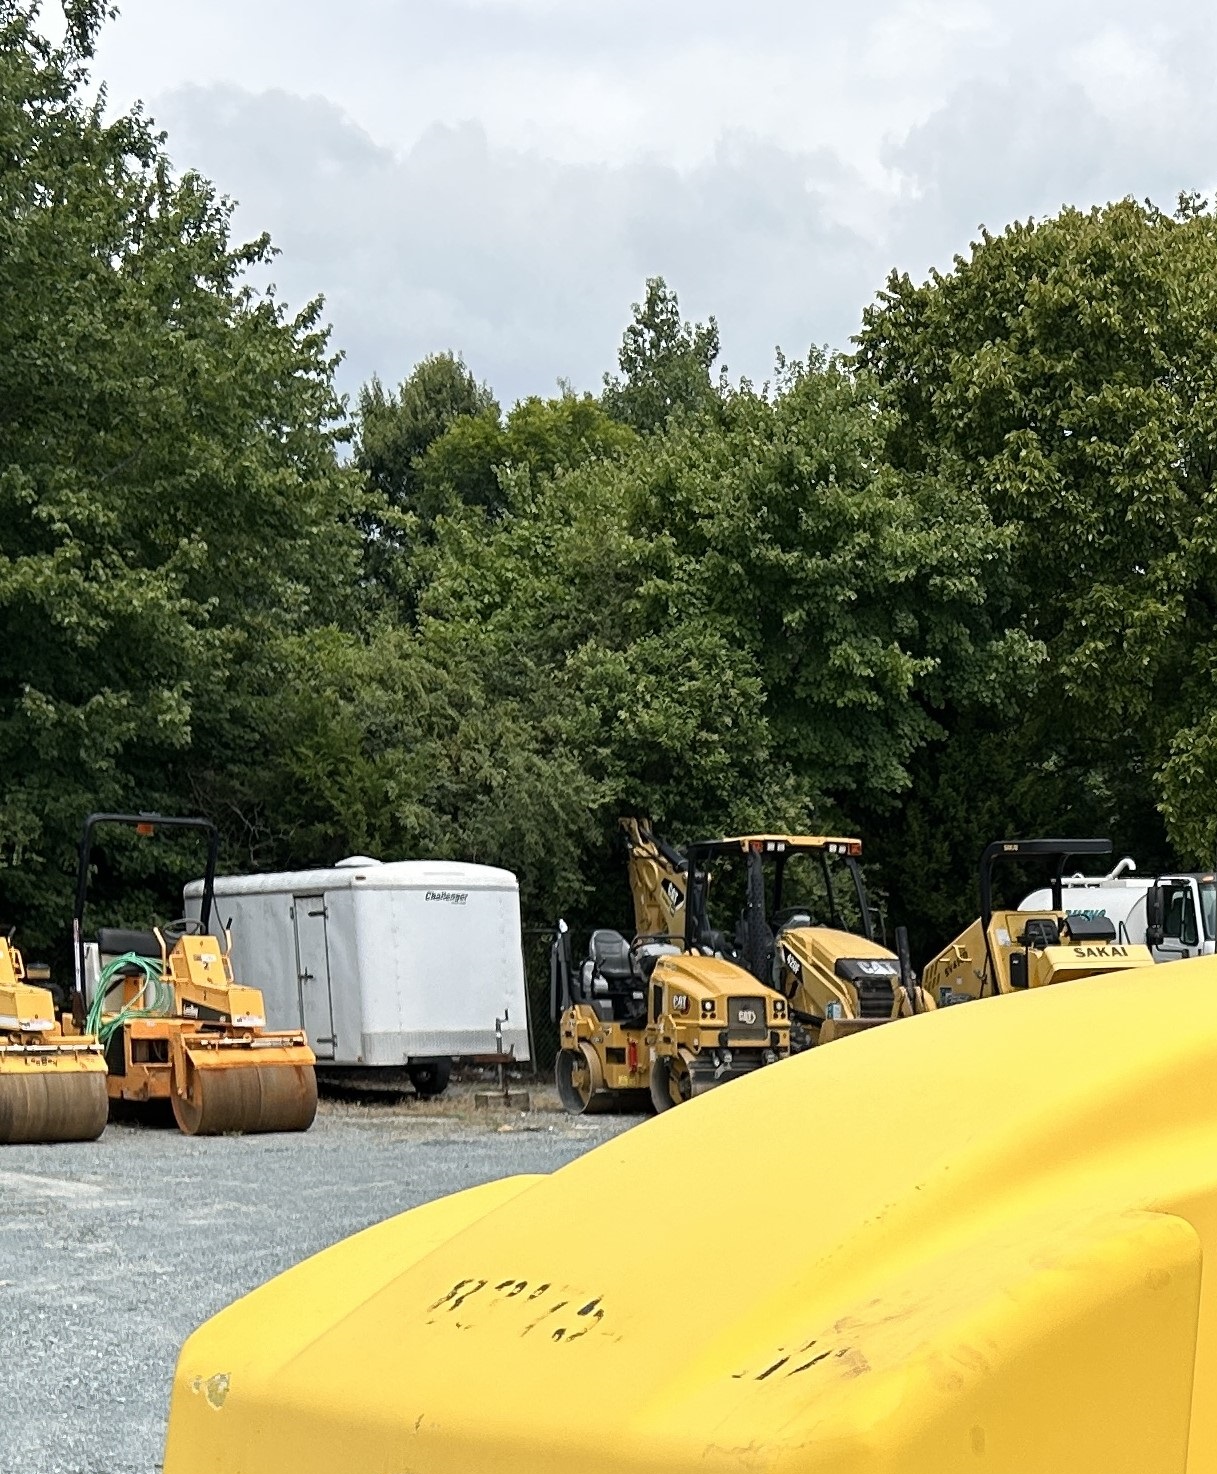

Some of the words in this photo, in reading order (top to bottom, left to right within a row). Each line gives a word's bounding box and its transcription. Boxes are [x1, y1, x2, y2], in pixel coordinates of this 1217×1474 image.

[1073, 946, 1129, 958] SAKAI
[857, 961, 898, 975] CAT
[673, 994, 687, 1010] CAT
